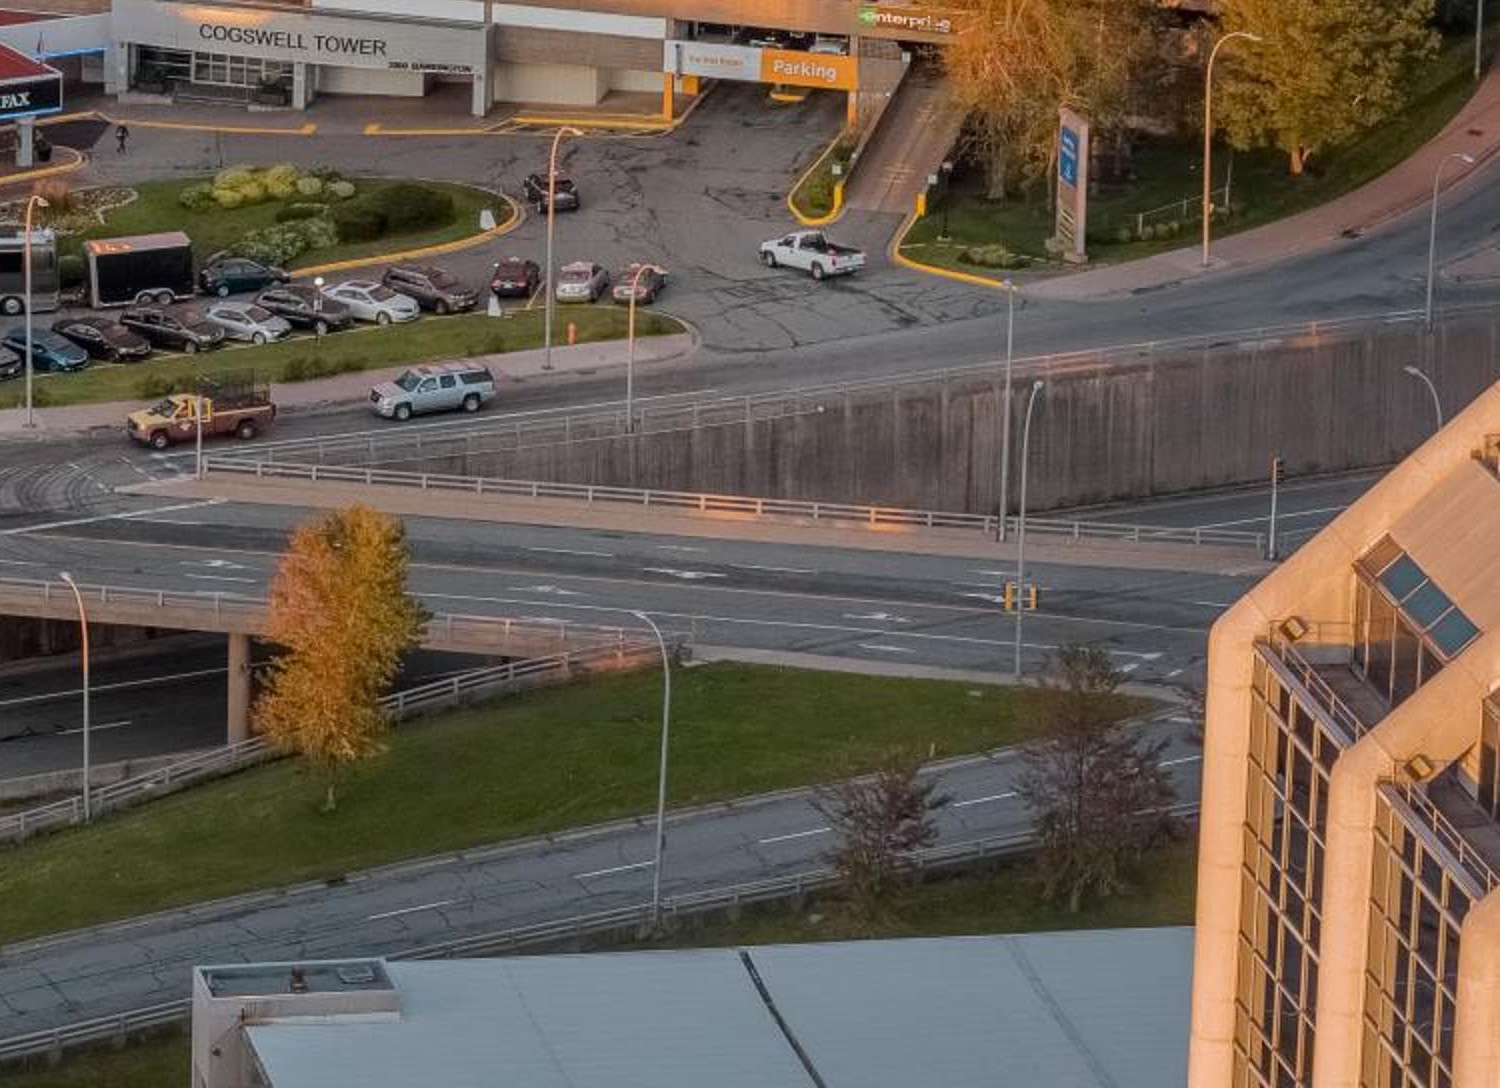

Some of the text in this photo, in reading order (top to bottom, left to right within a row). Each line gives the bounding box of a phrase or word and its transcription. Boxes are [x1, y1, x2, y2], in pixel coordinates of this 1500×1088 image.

[861, 9, 951, 33] enterprie
[199, 23, 387, 57] COGSWELL TOWER
[772, 58, 838, 83] Parking
